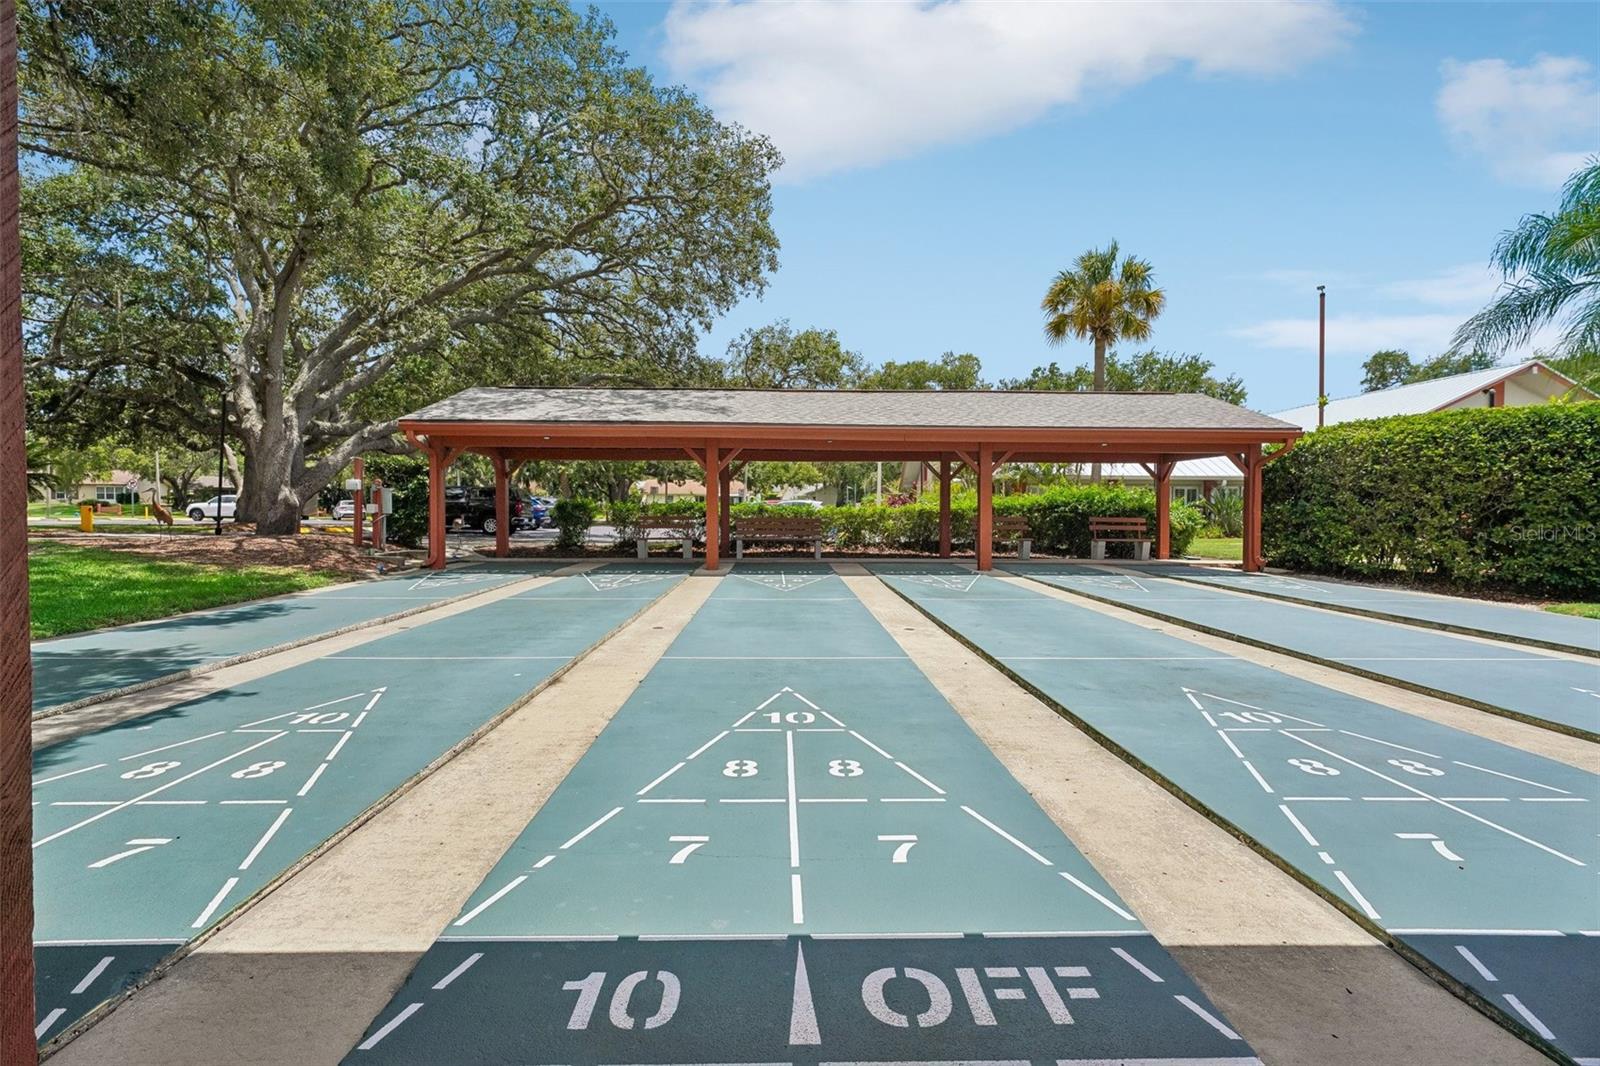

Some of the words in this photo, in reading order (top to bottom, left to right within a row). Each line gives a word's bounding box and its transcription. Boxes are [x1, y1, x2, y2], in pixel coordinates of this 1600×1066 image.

[290, 712, 350, 725] 10
[764, 711, 816, 724] 10
[1218, 711, 1283, 724] 10
[120, 760, 182, 779] 8
[230, 760, 287, 779] 8
[722, 759, 759, 778] 8
[828, 759, 864, 778] 8
[1287, 758, 1341, 776] 8
[1387, 759, 1445, 777] 8
[669, 835, 710, 864] 7
[877, 834, 918, 864] 7
[1395, 833, 1464, 862] 7
[562, 970, 682, 1030] 10
[861, 966, 1101, 1028] OFF
